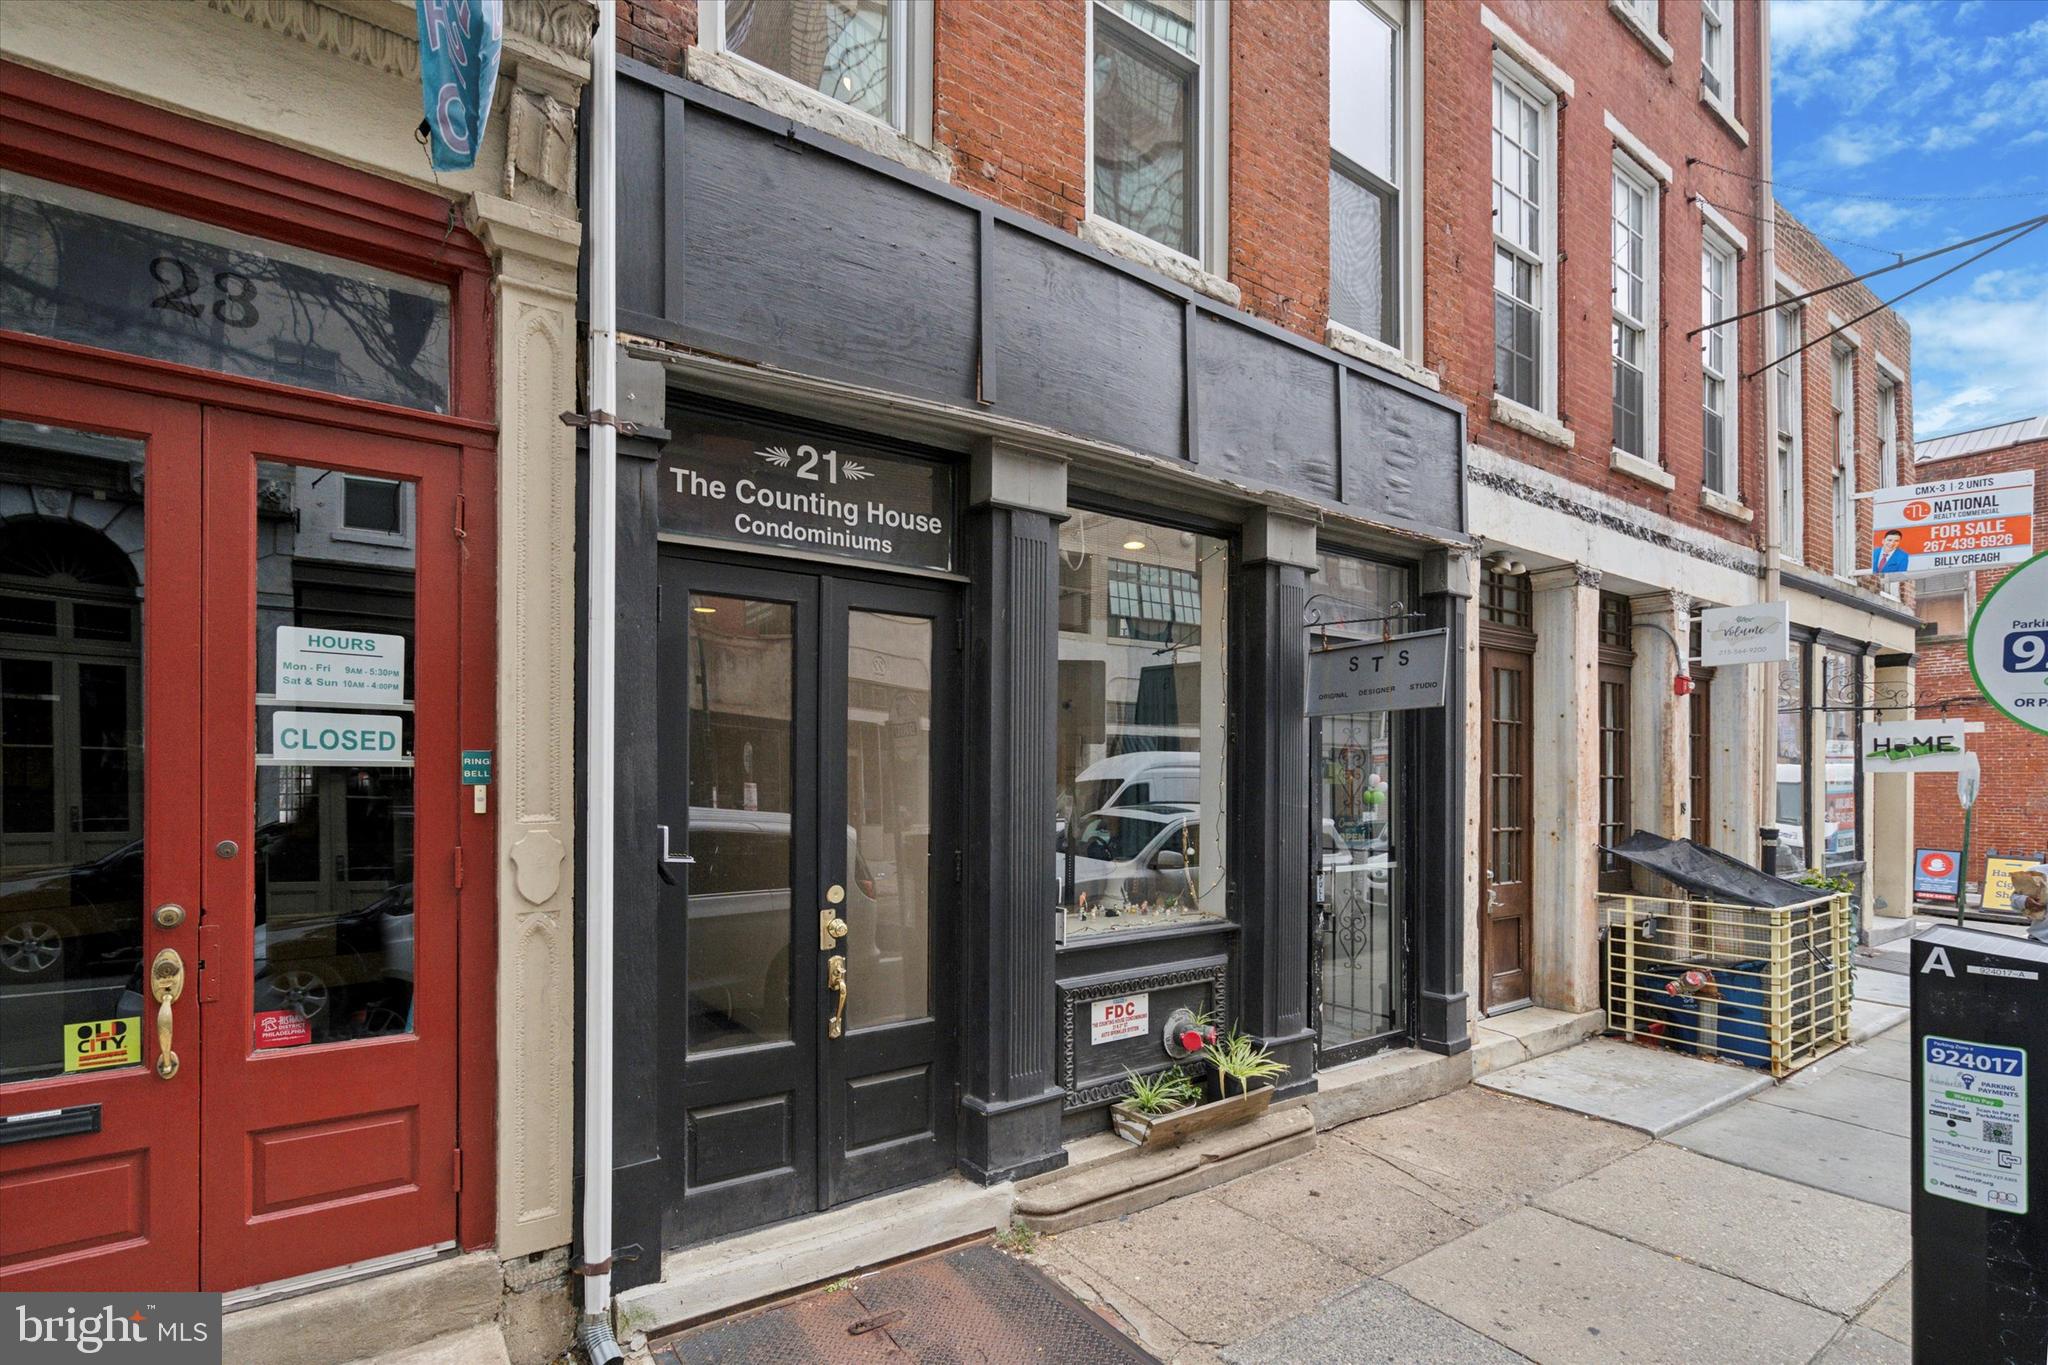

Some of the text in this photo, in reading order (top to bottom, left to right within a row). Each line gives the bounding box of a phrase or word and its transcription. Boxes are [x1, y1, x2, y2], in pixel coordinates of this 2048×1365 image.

[796, 444, 837, 484] 21
[1915, 478, 1994, 496] CMX-3 2 UNITS
[669, 466, 942, 534] The Counting House
[1934, 495, 1999, 513] NATIONAL
[1934, 508, 2000, 520] REALTY COMMERCIAL
[734, 512, 893, 554] Condominiums
[1931, 519, 2006, 539] FOR SALE
[1923, 533, 2014, 553] 267-439-6926
[1934, 552, 2000, 567] BILLY CREAGH
[2012, 619, 2048, 629] Parki
[308, 634, 376, 652] HOURS
[2012, 635, 2048, 670] 9
[282, 662, 306, 671] Mon
[316, 663, 331, 672] Fri
[345, 666, 363, 675] 9AM
[369, 668, 400, 677] 5:30PM
[282, 676, 301, 685] Sat
[304, 677, 313, 686] &
[316, 678, 338, 687] Sun
[343, 680, 364, 688] 10AM
[1318, 682, 1438, 701] ORIGINAL DESIGNER STUDIO
[2014, 698, 2035, 707] OR
[280, 727, 397, 751] CLOSED
[1920, 946, 1956, 978] A
[1105, 1001, 1135, 1020] FDC
[77, 1021, 127, 1039] OLD
[262, 1029, 306, 1038] PHILADELPHIA
[1931, 1048, 2018, 1074] 924017
[1978, 1087, 2019, 1098] PAYMENTS
[1981, 1081, 2016, 1091] PARKING
